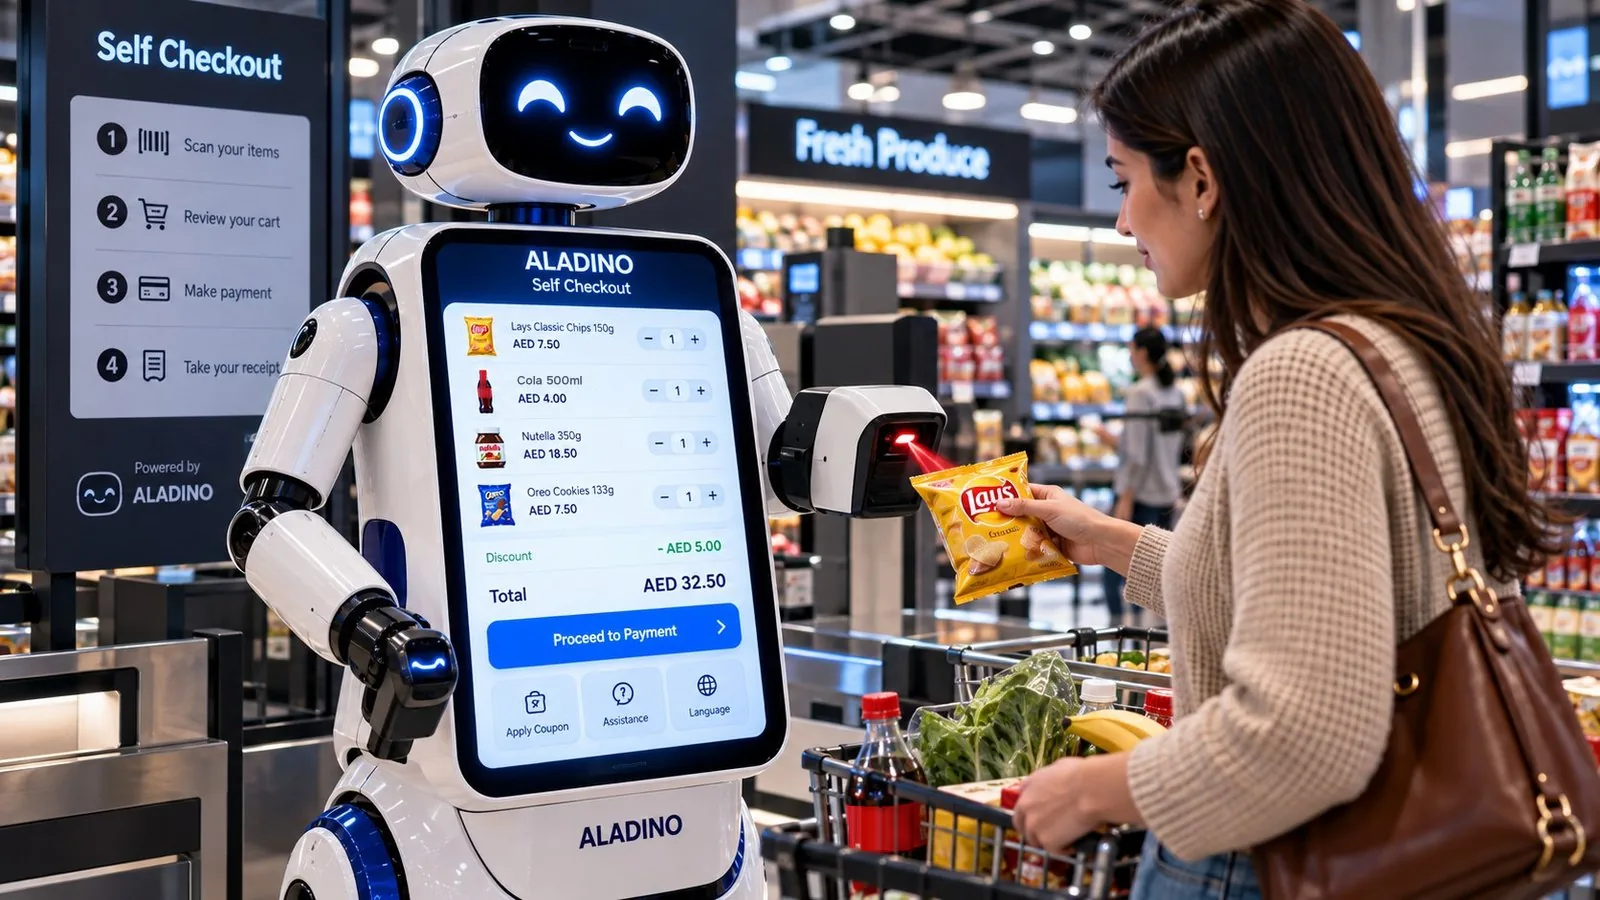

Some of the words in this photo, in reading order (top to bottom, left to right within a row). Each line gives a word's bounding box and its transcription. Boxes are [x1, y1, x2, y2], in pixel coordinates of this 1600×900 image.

[97, 31, 152, 65] Self
[159, 39, 282, 80] Checkout
[108, 130, 115, 147] 1
[185, 138, 214, 153] Scan
[218, 145, 244, 158] your
[248, 144, 279, 158] items
[796, 119, 873, 167] Fresh
[877, 128, 989, 179] Produce
[107, 203, 117, 220] 2
[185, 210, 226, 225] Review
[230, 216, 255, 229] your
[258, 217, 280, 228] cart
[525, 250, 633, 274] ALADINO
[107, 278, 118, 296] 3
[185, 284, 217, 297] Make
[221, 288, 272, 302] payment
[533, 278, 560, 291] Self
[564, 279, 631, 294] Checkout
[511, 322, 531, 333] Lays
[534, 322, 564, 331] Classic
[567, 323, 591, 334] Chips
[594, 324, 614, 335] 150g
[513, 339, 534, 348] AED
[538, 339, 560, 349] 7.50
[106, 356, 118, 374] 4
[184, 360, 210, 373] Take
[214, 364, 239, 377] your
[242, 361, 281, 376] receipt
[517, 376, 542, 385] Cola
[547, 376, 582, 385] 500ml
[519, 394, 540, 403] AED
[543, 394, 566, 403] 4.00
[522, 431, 555, 440] Nutella
[558, 431, 581, 442] 350g
[524, 449, 545, 459] AED
[549, 448, 577, 458] 18.50
[135, 460, 183, 473] Powered
[187, 460, 200, 474] by
[133, 484, 213, 503] ALADINO
[527, 488, 550, 497] Oreo
[553, 486, 589, 496] Cookies
[592, 485, 614, 496] 133g
[530, 505, 551, 515] AED
[555, 504, 577, 514] 7.50
[667, 542, 691, 553] AED
[695, 540, 721, 552] 5.00
[486, 551, 532, 563] Discount
[644, 577, 677, 592] AED
[682, 573, 725, 590] 32.50
[489, 587, 526, 603] Total
[554, 630, 604, 646] Proceed
[608, 630, 620, 641] to
[624, 625, 677, 642] Payment
[689, 706, 730, 717] Language
[603, 715, 648, 726] Assistance
[506, 727, 531, 738] Apply
[534, 724, 569, 734] Coupon
[579, 815, 682, 849] ALADINO
